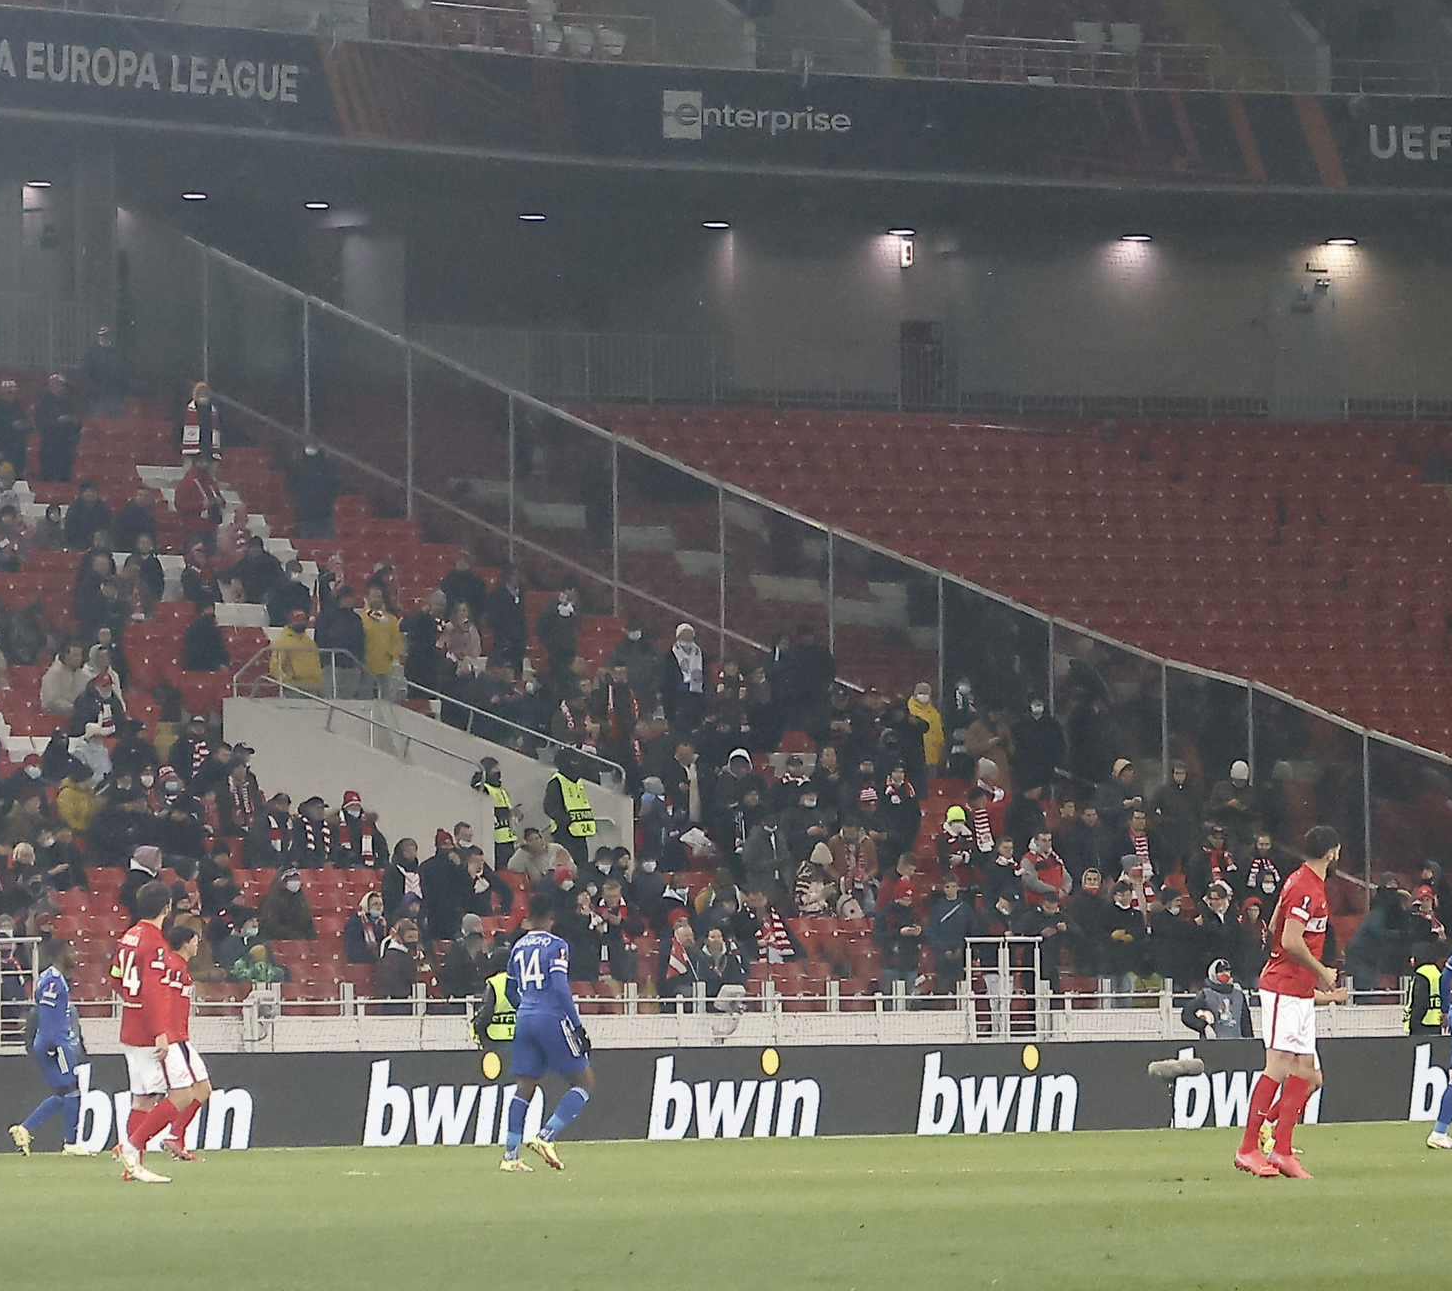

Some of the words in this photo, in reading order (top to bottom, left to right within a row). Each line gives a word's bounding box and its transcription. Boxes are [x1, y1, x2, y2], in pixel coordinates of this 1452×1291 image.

[26, 41, 161, 90] EUROPA
[170, 53, 299, 103] LEAGUE
[672, 99, 852, 136] enterprise
[118, 948, 142, 997] 14
[513, 948, 545, 991] 14
[647, 1048, 820, 1141] bwin
[915, 1045, 1079, 1136] bwin
